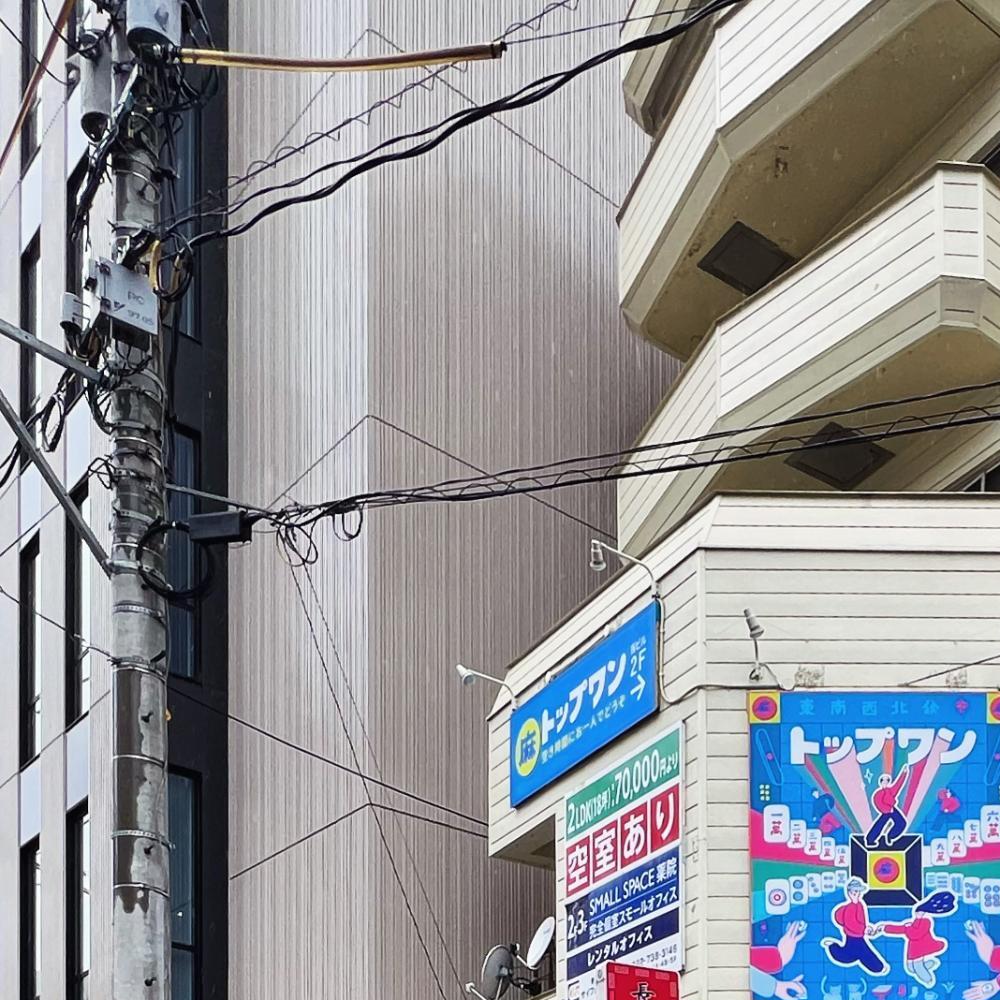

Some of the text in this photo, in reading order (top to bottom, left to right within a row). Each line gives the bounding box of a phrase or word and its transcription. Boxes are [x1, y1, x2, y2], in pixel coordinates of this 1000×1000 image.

[630, 647, 647, 677] 2F
[541, 653, 627, 745] トップワン
[790, 726, 977, 765] トップワン
[567, 792, 675, 892] 空室あり
[589, 857, 677, 917] SMALL SPACE 薬院
[587, 925, 653, 967] レンタルオフィス
